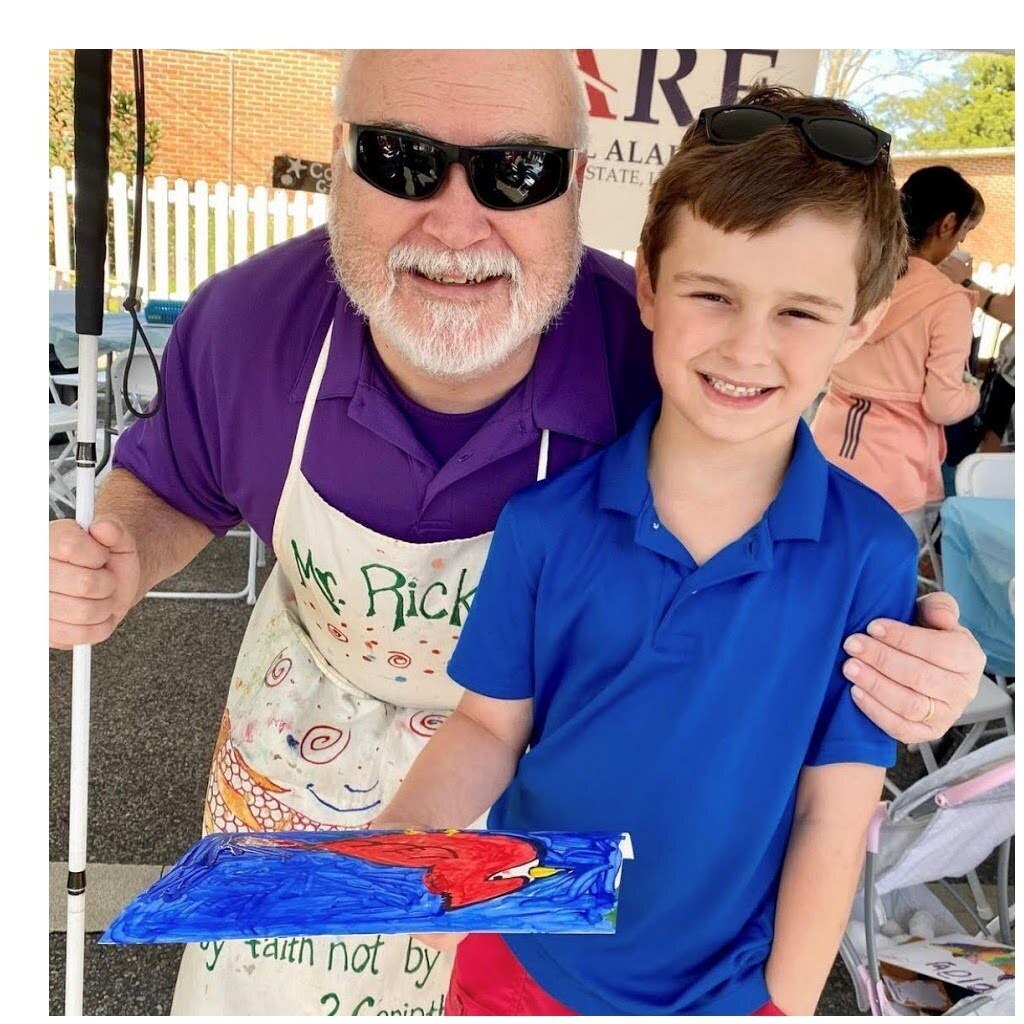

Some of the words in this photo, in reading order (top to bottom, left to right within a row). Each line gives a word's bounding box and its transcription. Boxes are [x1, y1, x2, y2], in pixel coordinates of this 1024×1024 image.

[360, 563, 477, 631] Rick
[327, 935, 384, 975] not
[404, 936, 441, 988] by
